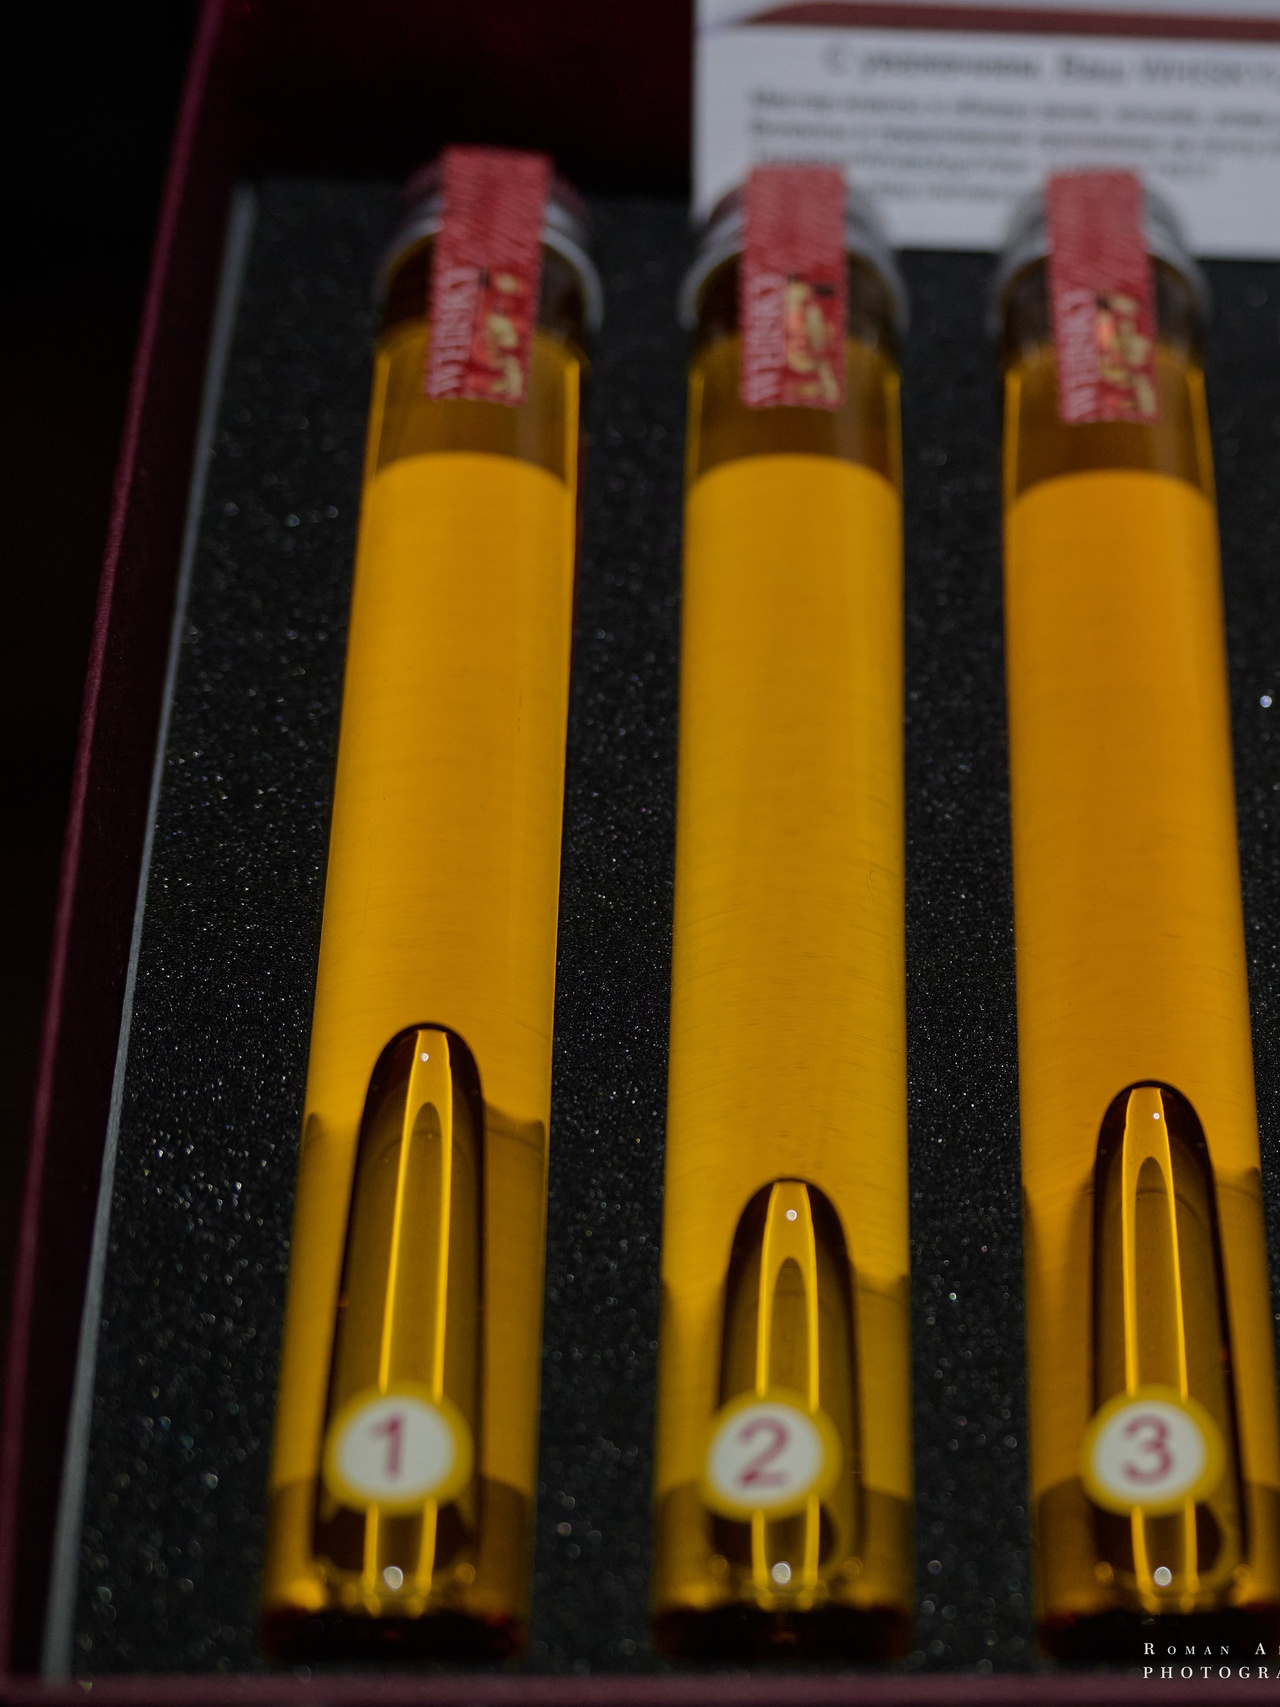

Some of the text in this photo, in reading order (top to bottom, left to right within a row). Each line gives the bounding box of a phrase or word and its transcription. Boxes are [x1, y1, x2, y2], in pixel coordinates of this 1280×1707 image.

[370, 1409, 404, 1481] 1
[738, 1416, 790, 1487] 2
[1123, 1414, 1174, 1487] 3
